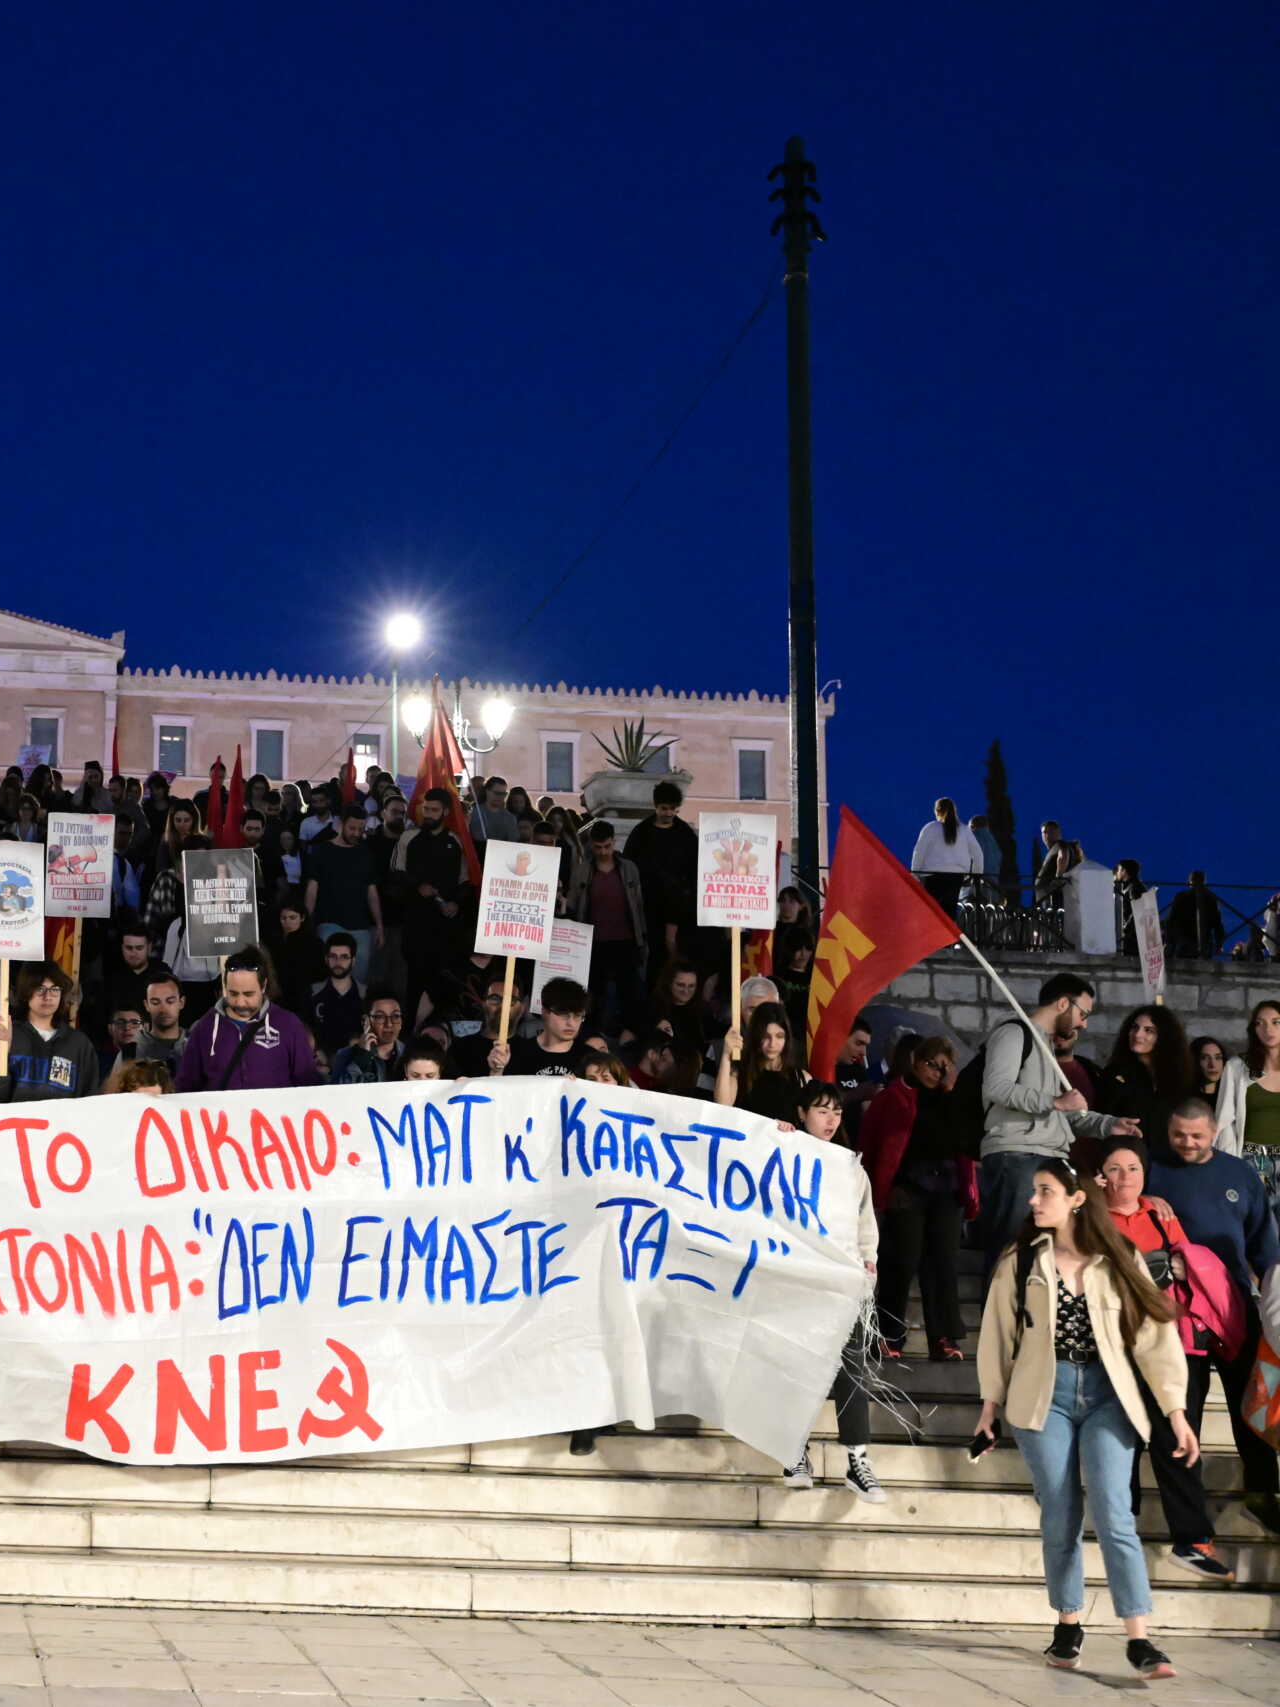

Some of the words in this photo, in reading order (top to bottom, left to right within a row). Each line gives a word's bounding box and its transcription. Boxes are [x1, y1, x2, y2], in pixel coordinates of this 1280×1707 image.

[524, 881, 549, 892] ΑΓΩΝΑ
[705, 873, 769, 885] ΣΥΛΛΟΓΙΚΟΣ
[489, 887, 499, 896] ΝΑ
[521, 890, 528, 899] Η
[529, 891, 548, 902] ΟΡΓΗ
[706, 883, 767, 896] ΑΓΩΝΑΣ
[495, 902, 539, 914] ΧΡΕΟΣ
[502, 912, 527, 923] ΓΕΝΙΑΣ
[529, 914, 546, 927] ΜΑΣ
[484, 922, 491, 936] Η
[494, 922, 544, 944] ΑΝΑΤΡΟΠΗ
[502, 943, 517, 951] ΚΝΕ
[134, 1106, 361, 1199] ΔΙΚΑΙΟ:
[366, 1094, 493, 1191] ΜΑΤ
[559, 1095, 830, 1236] ΚΑΤΑΣΤΟΛΗ
[194, 1207, 315, 1320] "ΔΕΝ
[337, 1208, 581, 1309] ΕΙΜΑΣΤΕ
[596, 1197, 792, 1299] ΤΑΞΙ"
[64, 1349, 289, 1455] ΚΝΕ
